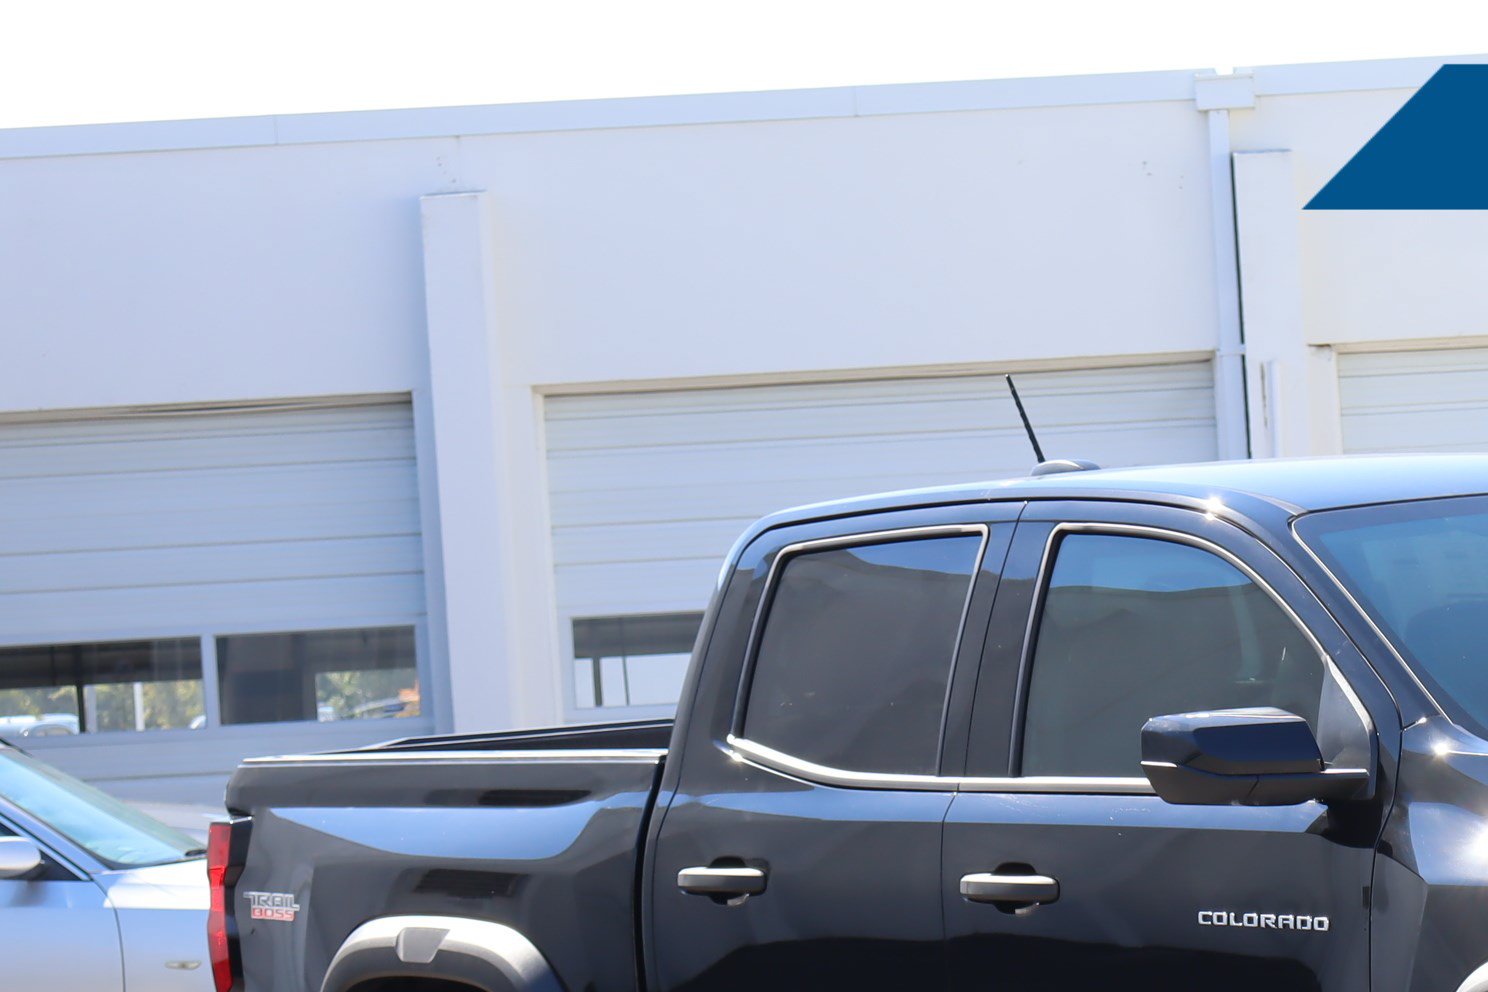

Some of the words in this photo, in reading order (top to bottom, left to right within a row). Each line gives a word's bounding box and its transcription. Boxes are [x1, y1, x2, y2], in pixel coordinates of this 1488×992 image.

[243, 891, 300, 911] TRAIL
[251, 906, 295, 921] BOSS
[1197, 910, 1330, 932] COLORADO
